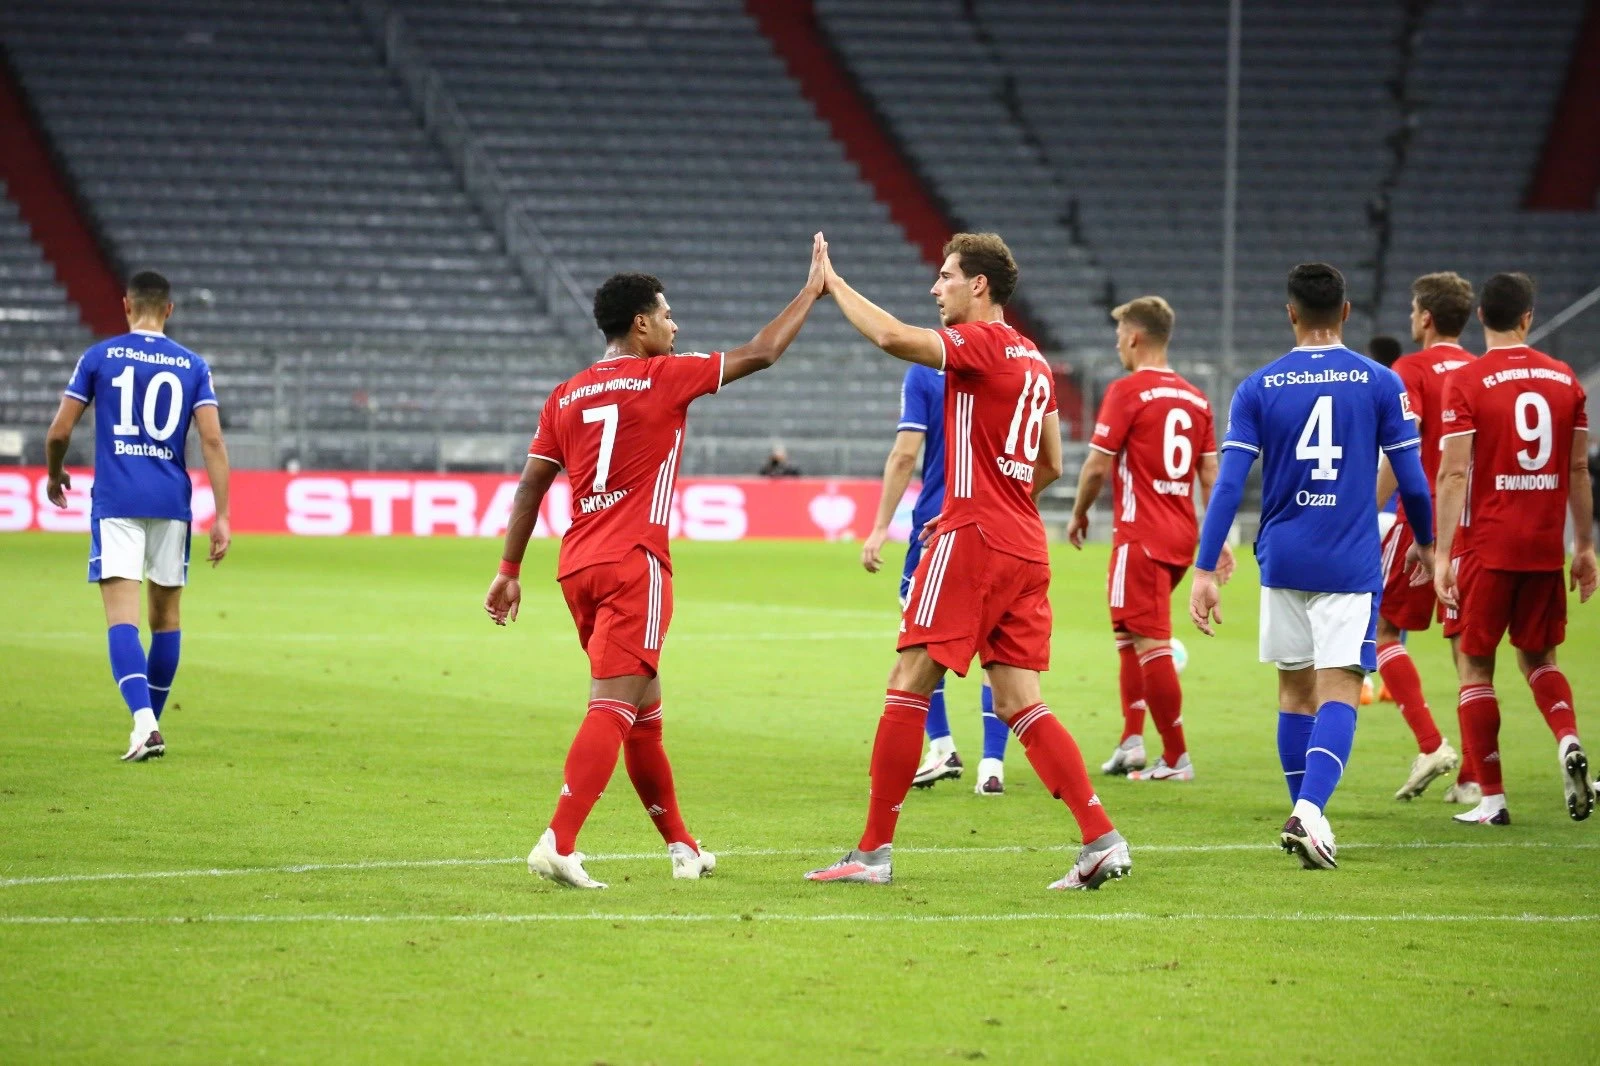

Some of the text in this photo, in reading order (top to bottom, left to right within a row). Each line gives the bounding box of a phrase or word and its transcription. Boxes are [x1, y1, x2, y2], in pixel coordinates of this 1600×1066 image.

[106, 347, 191, 369] FC Schalke 04
[1263, 369, 1369, 388] FC Schalke 04
[1482, 375, 1497, 389] FC
[111, 365, 184, 442] 10
[559, 394, 571, 409] FC
[570, 382, 604, 403] BAYERN
[1004, 370, 1050, 462] 18
[1163, 407, 1193, 480] 6
[1295, 395, 1343, 480] 4
[1514, 391, 1552, 471] 9
[113, 440, 174, 460] Bentaeb
[582, 403, 619, 493] 7
[996, 456, 1035, 484] GORETZ
[579, 488, 634, 514] GNABR
[1295, 490, 1337, 507] Ozan
